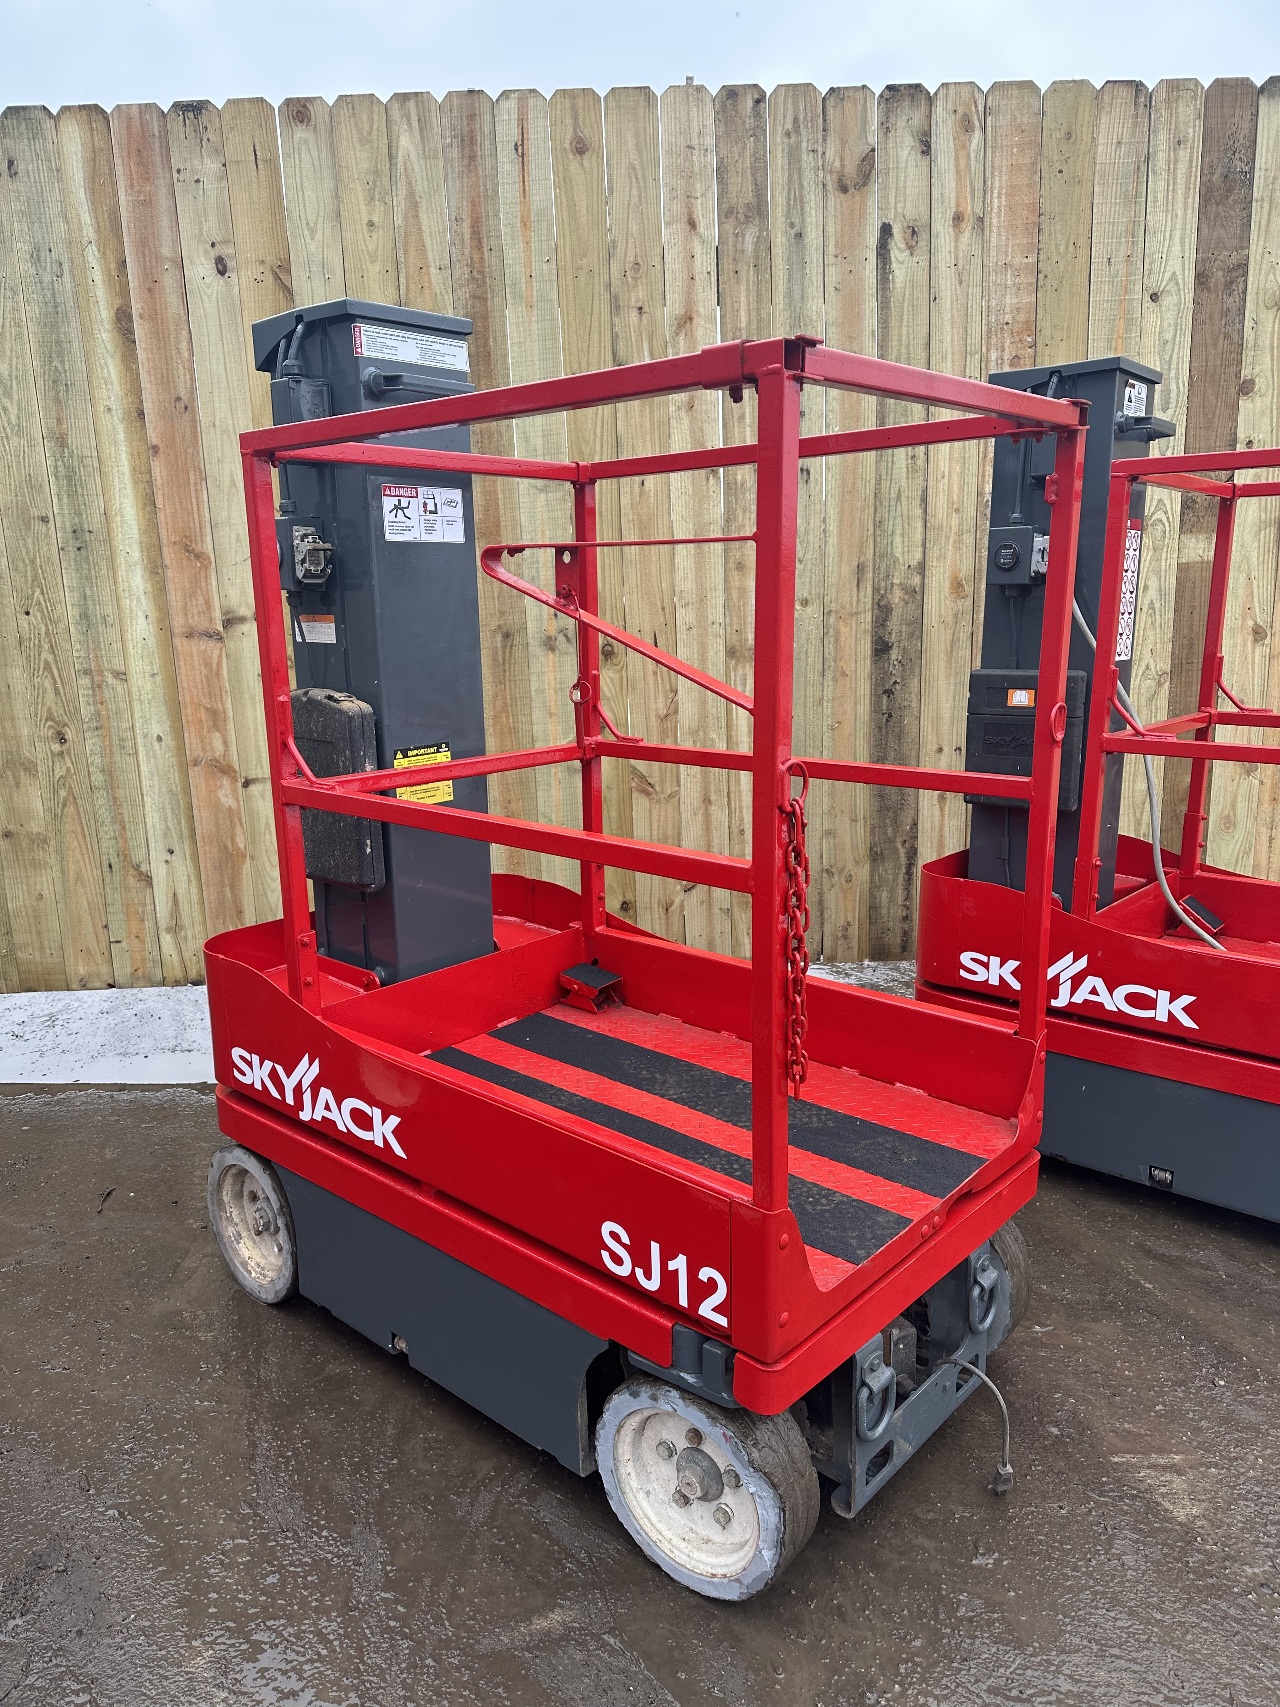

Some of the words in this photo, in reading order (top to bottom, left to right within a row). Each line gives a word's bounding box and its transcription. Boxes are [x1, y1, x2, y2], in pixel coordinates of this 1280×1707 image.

[390, 487, 417, 497] DANGER
[407, 747, 437, 756] IMPORTANT
[231, 1046, 408, 1160] SKYJACK
[600, 1220, 728, 1328] SJ12
